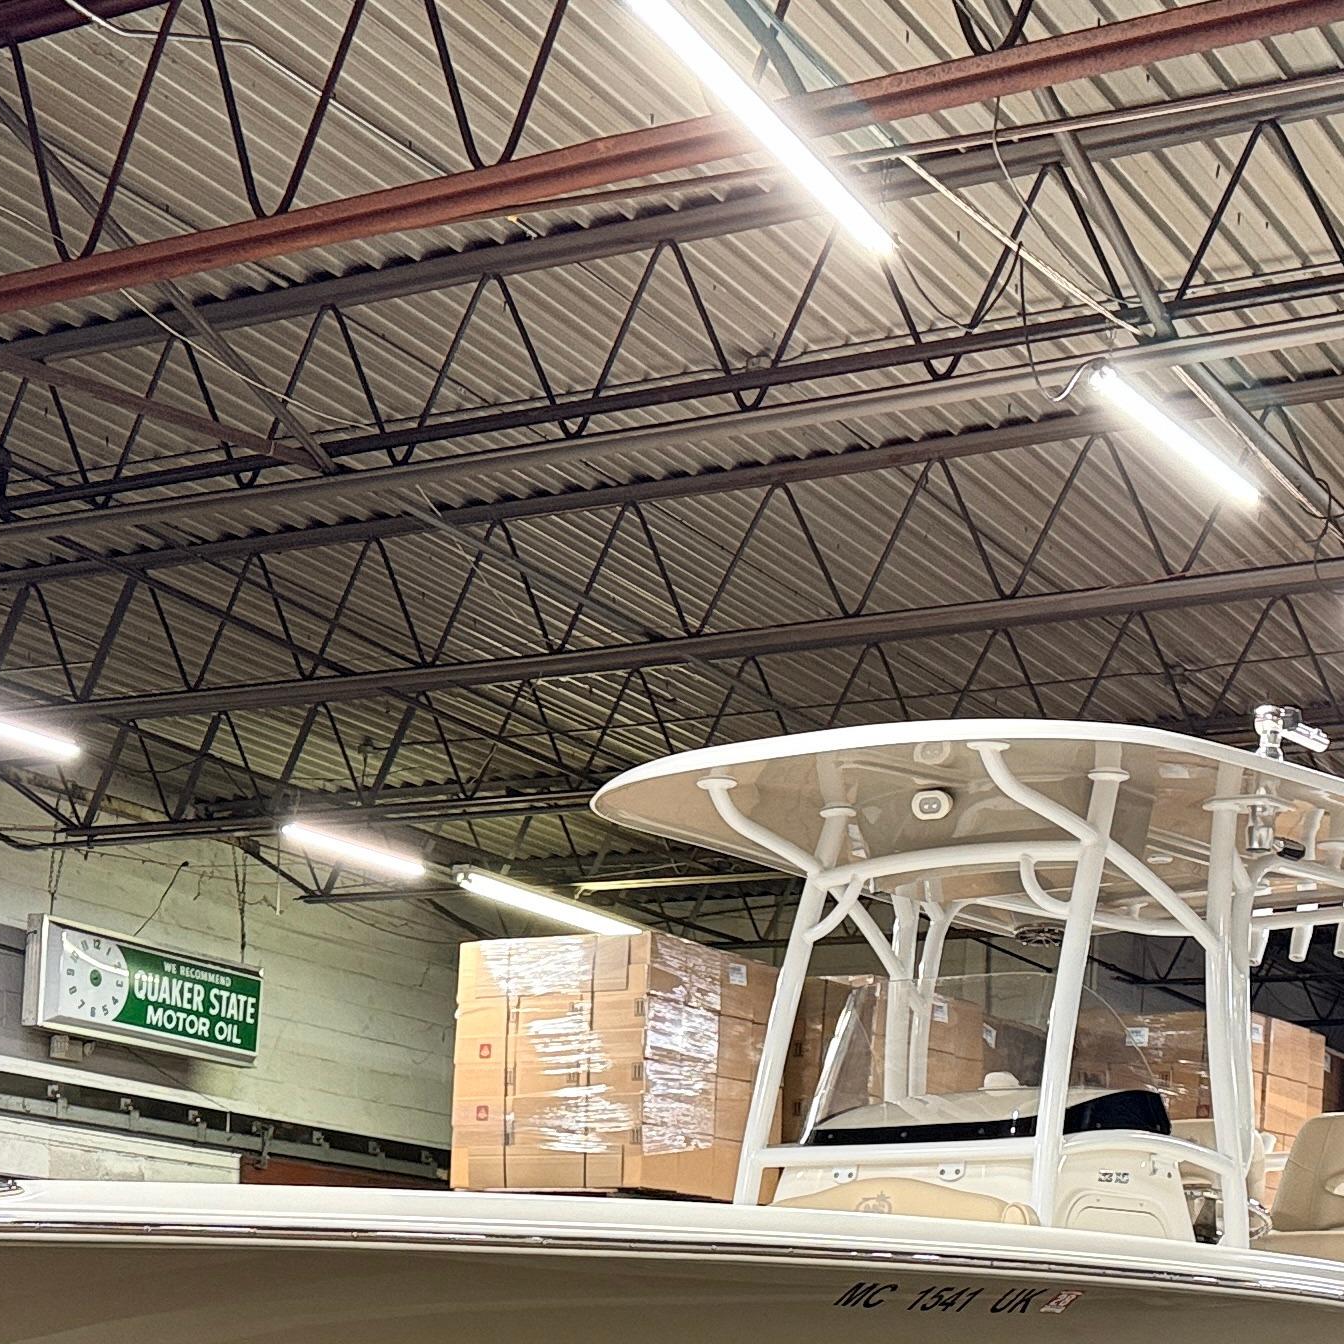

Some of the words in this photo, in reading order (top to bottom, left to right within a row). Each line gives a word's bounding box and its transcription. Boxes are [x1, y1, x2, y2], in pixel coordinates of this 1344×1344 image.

[93, 939, 102, 951] 12
[163, 962, 177, 975] WE
[179, 965, 232, 987] RECOMMEND
[133, 970, 205, 1013] QUAKER
[208, 988, 257, 1025] STATE
[146, 1005, 210, 1038] MOTOR
[214, 1021, 242, 1045] OIL
[833, 1281, 898, 1309] MC
[906, 1285, 985, 1312] 1541
[989, 1288, 1049, 1314] UK
